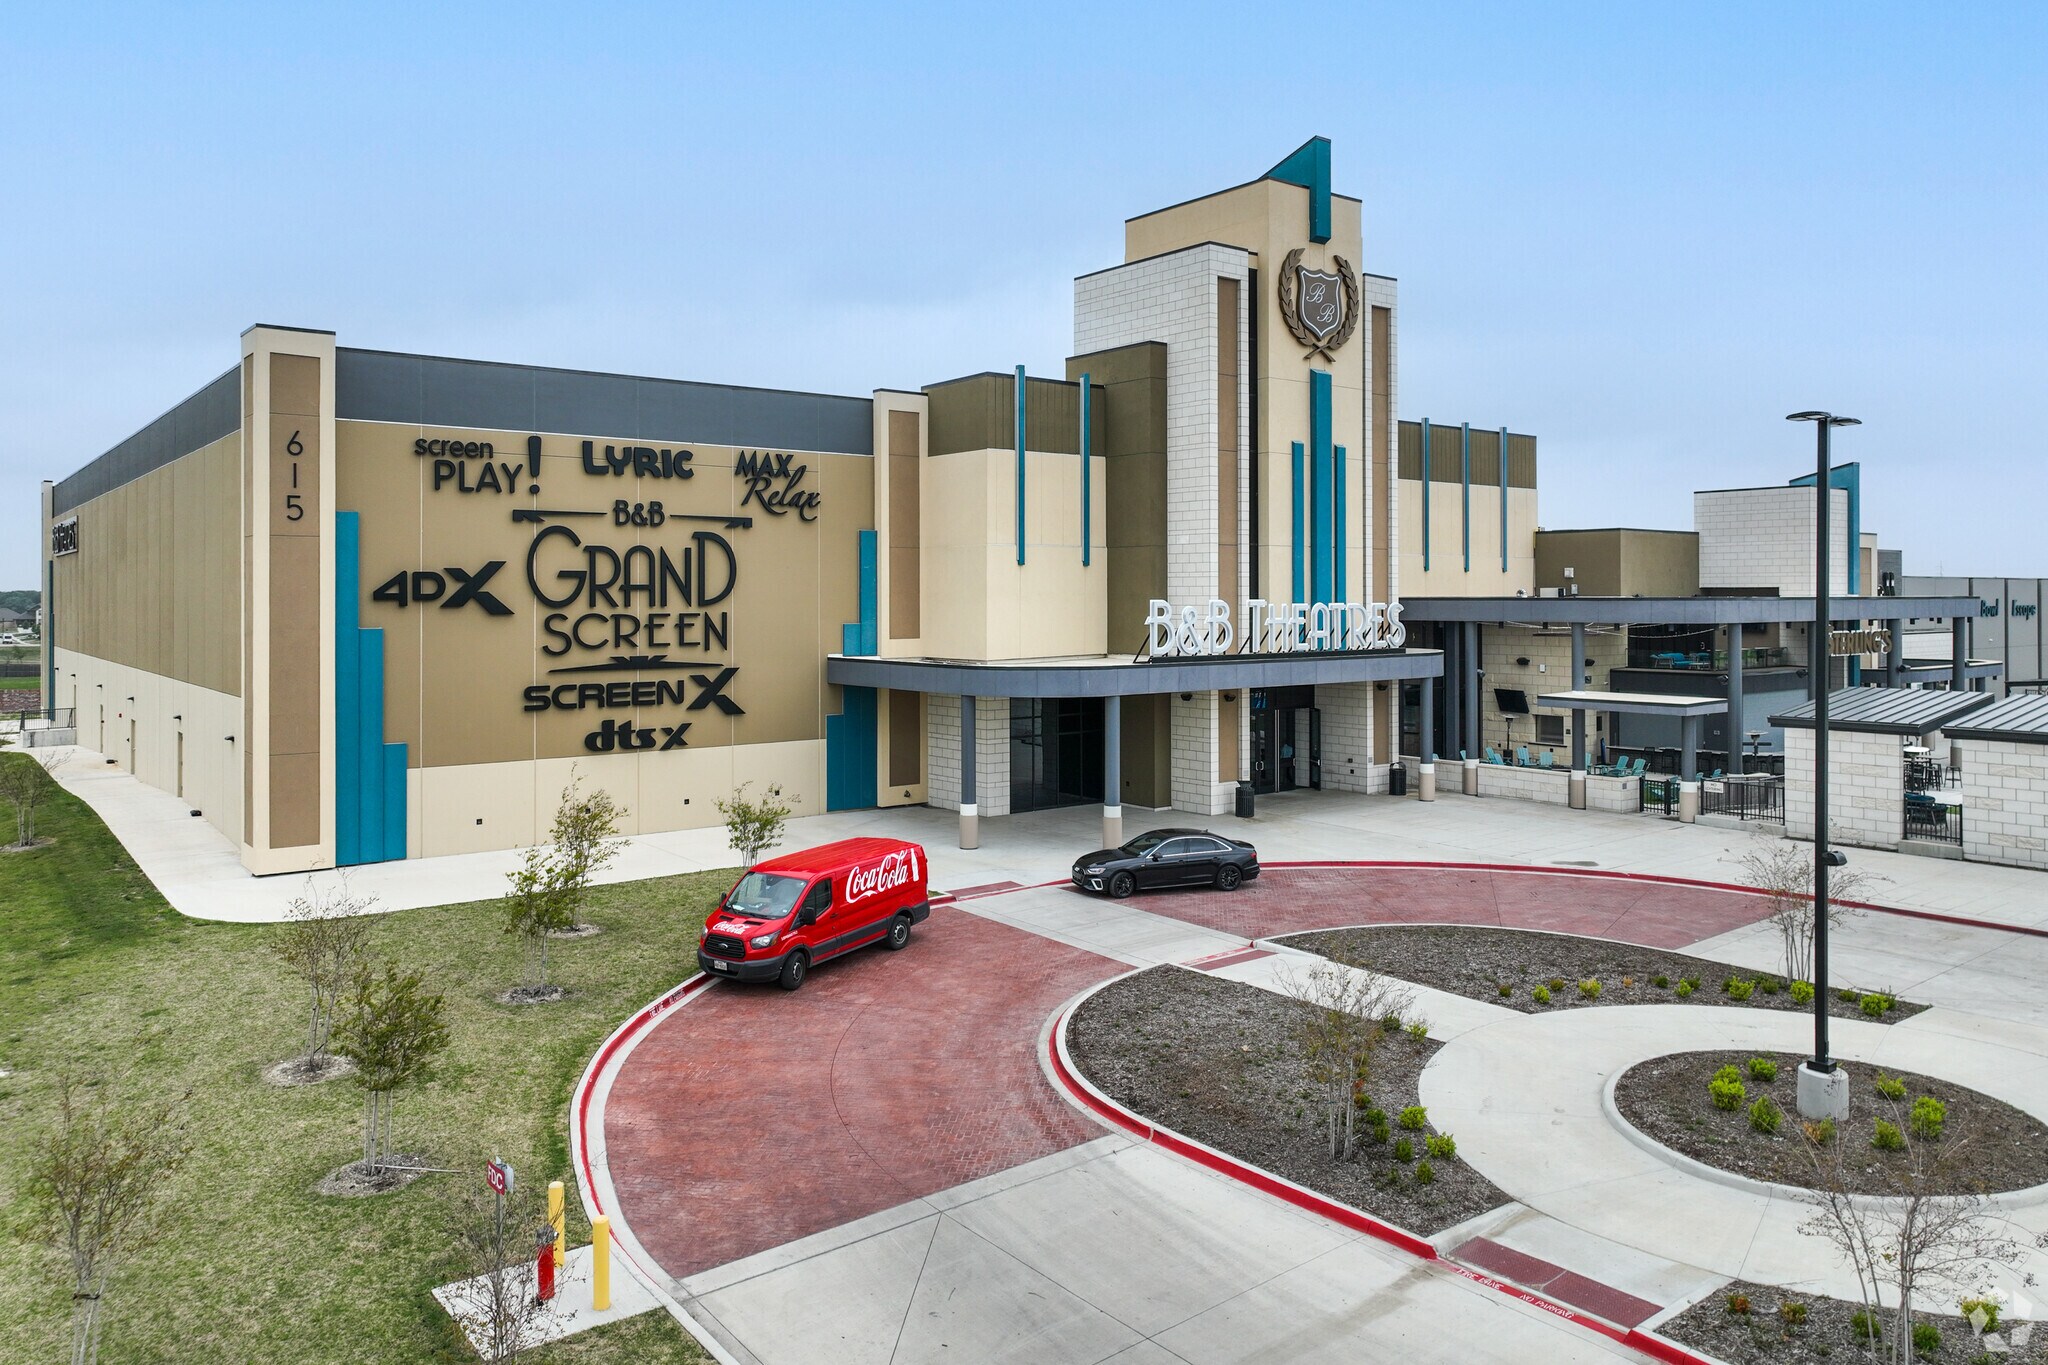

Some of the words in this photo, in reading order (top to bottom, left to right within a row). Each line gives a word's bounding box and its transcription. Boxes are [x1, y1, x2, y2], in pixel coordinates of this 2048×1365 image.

[414, 437, 494, 460] screen
[582, 440, 695, 479] LYRIC
[735, 450, 795, 478] MAX
[614, 500, 665, 527] B&B
[741, 464, 821, 522] Relax
[373, 560, 515, 615] 4DX
[526, 525, 737, 609] GRAND
[542, 611, 728, 657] SCREEN
[1144, 599, 1234, 657] B&B
[1246, 599, 1407, 653] THEATRES
[845, 849, 909, 904] Coca-Cola
[487, 1164, 503, 1189] FDC
